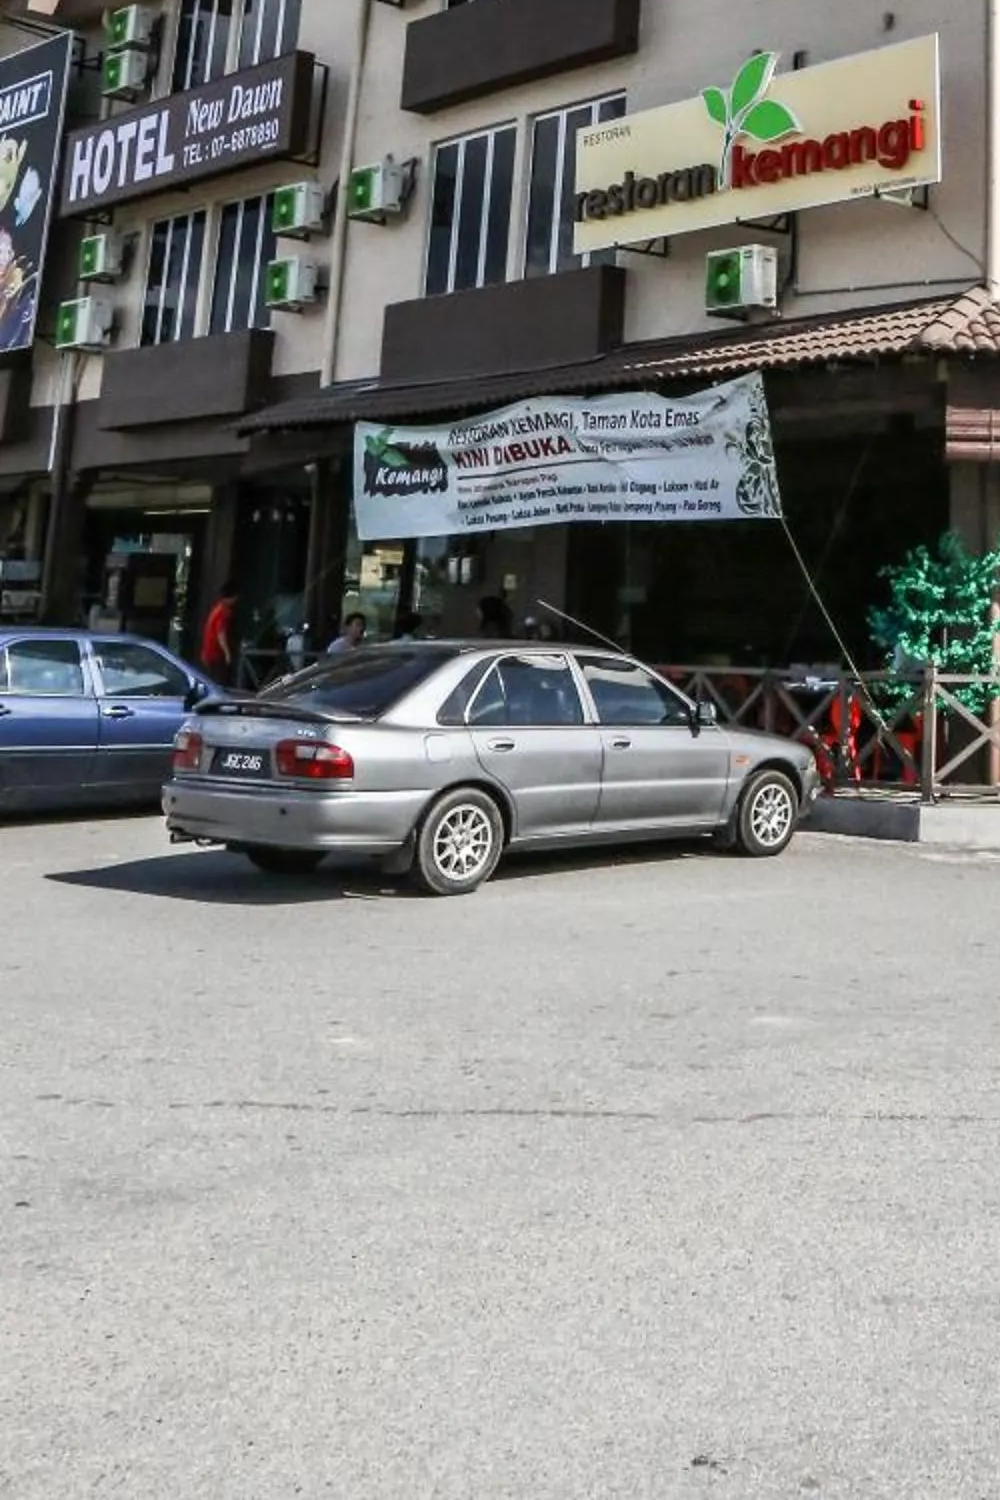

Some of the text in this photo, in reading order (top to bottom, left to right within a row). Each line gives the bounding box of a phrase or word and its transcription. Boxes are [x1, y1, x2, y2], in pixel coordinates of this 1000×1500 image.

[0, 82, 43, 124] AINT
[184, 77, 283, 138] New Dawn
[68, 108, 175, 202] HOTEL
[573, 99, 924, 223] restoran kemangi
[582, 411, 627, 430] Taman
[630, 409, 661, 429] Kota
[665, 408, 700, 427] Emas
[375, 466, 444, 487] Kemangi
[450, 449, 490, 470] KINI
